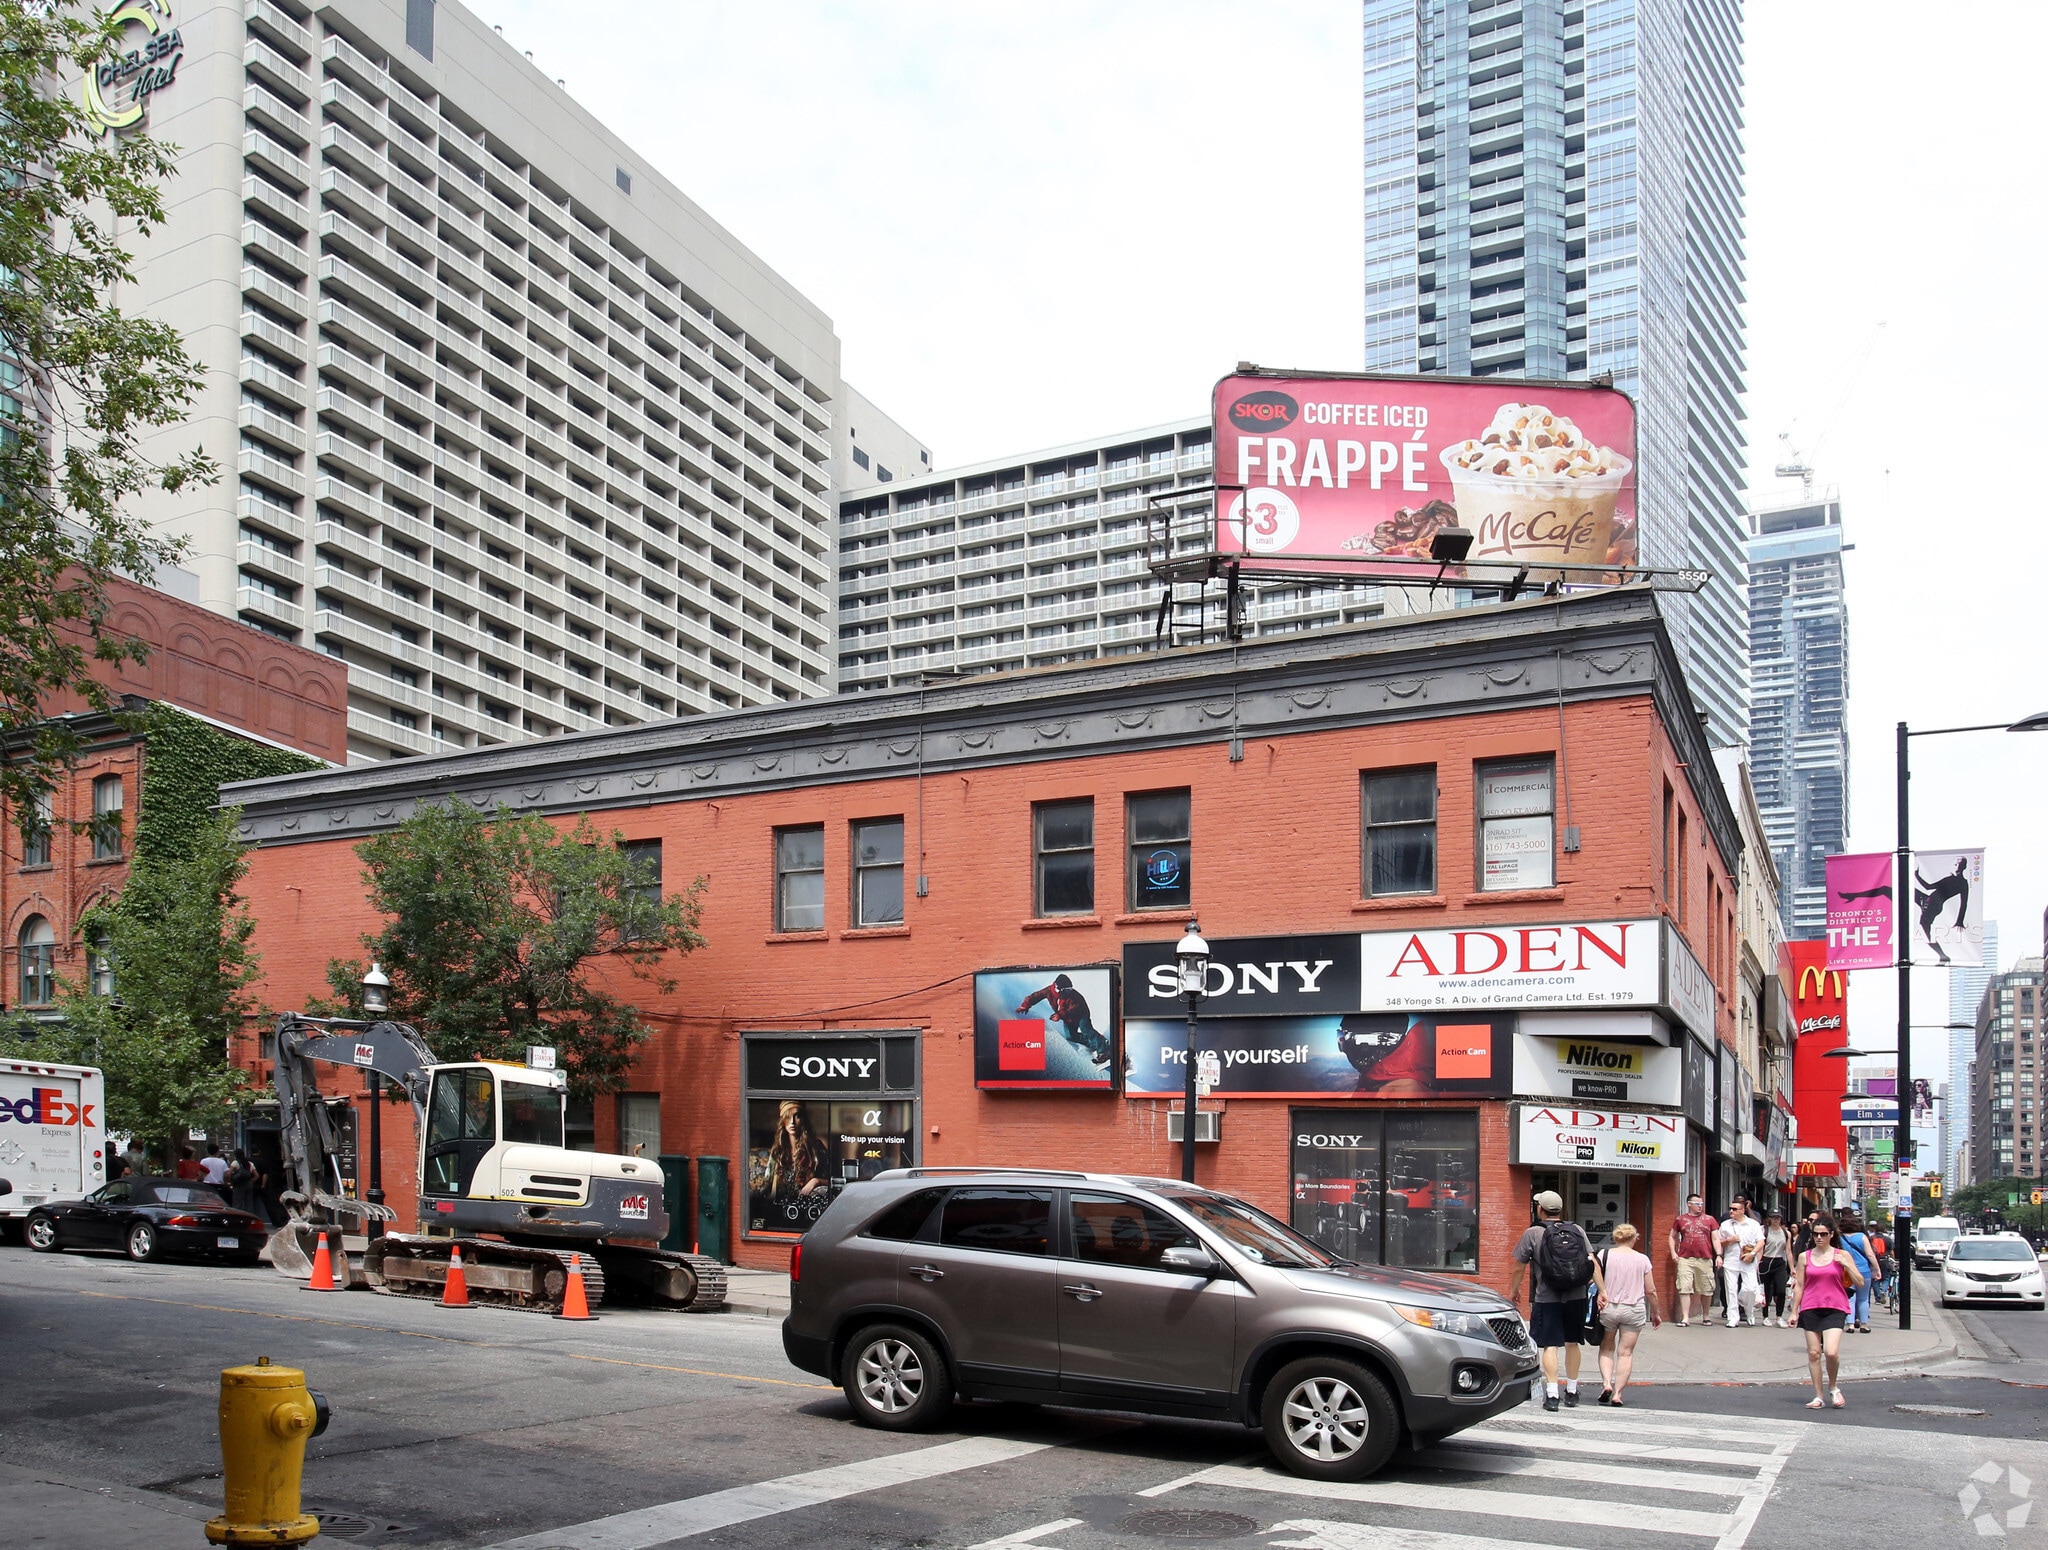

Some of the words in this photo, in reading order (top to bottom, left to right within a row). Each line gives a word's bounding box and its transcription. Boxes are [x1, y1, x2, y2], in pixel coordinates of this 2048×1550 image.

[99, 28, 184, 87] CHELSEA
[130, 52, 183, 102] Hotel
[1235, 403, 1291, 422] SKOR
[1303, 402, 1379, 426] COFFEE
[1383, 405, 1428, 428] ICED
[1237, 429, 1429, 492] FRAPPÉ
[1478, 511, 1595, 556] McCafé
[1678, 570, 1708, 582] 5550
[1493, 783, 1551, 794] COMMERCIAL
[1505, 840, 1546, 850] 743-5000
[1828, 909, 1882, 918] TORONTO'S
[1829, 917, 1872, 925] DISTRICT
[1826, 926, 1879, 948] THE
[1386, 923, 1635, 978] ADEN
[1148, 960, 1334, 998] SONY
[1438, 975, 1575, 988] www.adencamera.com
[1672, 941, 1709, 1019] ADEN
[1386, 997, 1402, 1005] 348
[1404, 996, 1432, 1006] Yonge
[1435, 996, 1447, 1005] St.
[1452, 995, 1460, 1004] A
[1462, 995, 1479, 1004] Div.
[1481, 994, 1491, 1003] of
[1493, 993, 1523, 1003] Grand
[1526, 993, 1563, 1002] Camera
[1566, 992, 1585, 1002] Ltd.
[1588, 992, 1607, 1001] Est.
[1611, 991, 1634, 1000] 1979
[1800, 1015, 1842, 1033] McCafé
[1003, 1041, 1042, 1049] ActionCam
[1223, 1044, 1309, 1068] yourself
[1440, 1047, 1487, 1056] ActionCam
[1566, 1044, 1632, 1069] Nikon
[780, 1056, 877, 1078] SONY
[1205, 1060, 1213, 1068] NO
[1199, 1067, 1219, 1077] STANDING
[1557, 1068, 1591, 1076] PROFESSIONAL
[1593, 1071, 1623, 1079] AUTHORIZED
[1526, 1108, 1681, 1133] ADEN
[1857, 1110, 1873, 1118] Elm
[1876, 1111, 1884, 1119] St
[41, 1127, 72, 1137] Express
[840, 1134, 857, 1144] Step
[867, 1136, 883, 1144] your
[884, 1135, 906, 1144] vision
[1296, 1134, 1363, 1147] SONY
[1556, 1133, 1597, 1145] Canon
[863, 1150, 882, 1158] 4K
[1578, 1148, 1593, 1156] PRO
[1620, 1143, 1655, 1155] Nikon
[1561, 1159, 1644, 1168] www.adencamera.com
[501, 1189, 515, 1197] 502
[622, 1196, 647, 1209] MC
